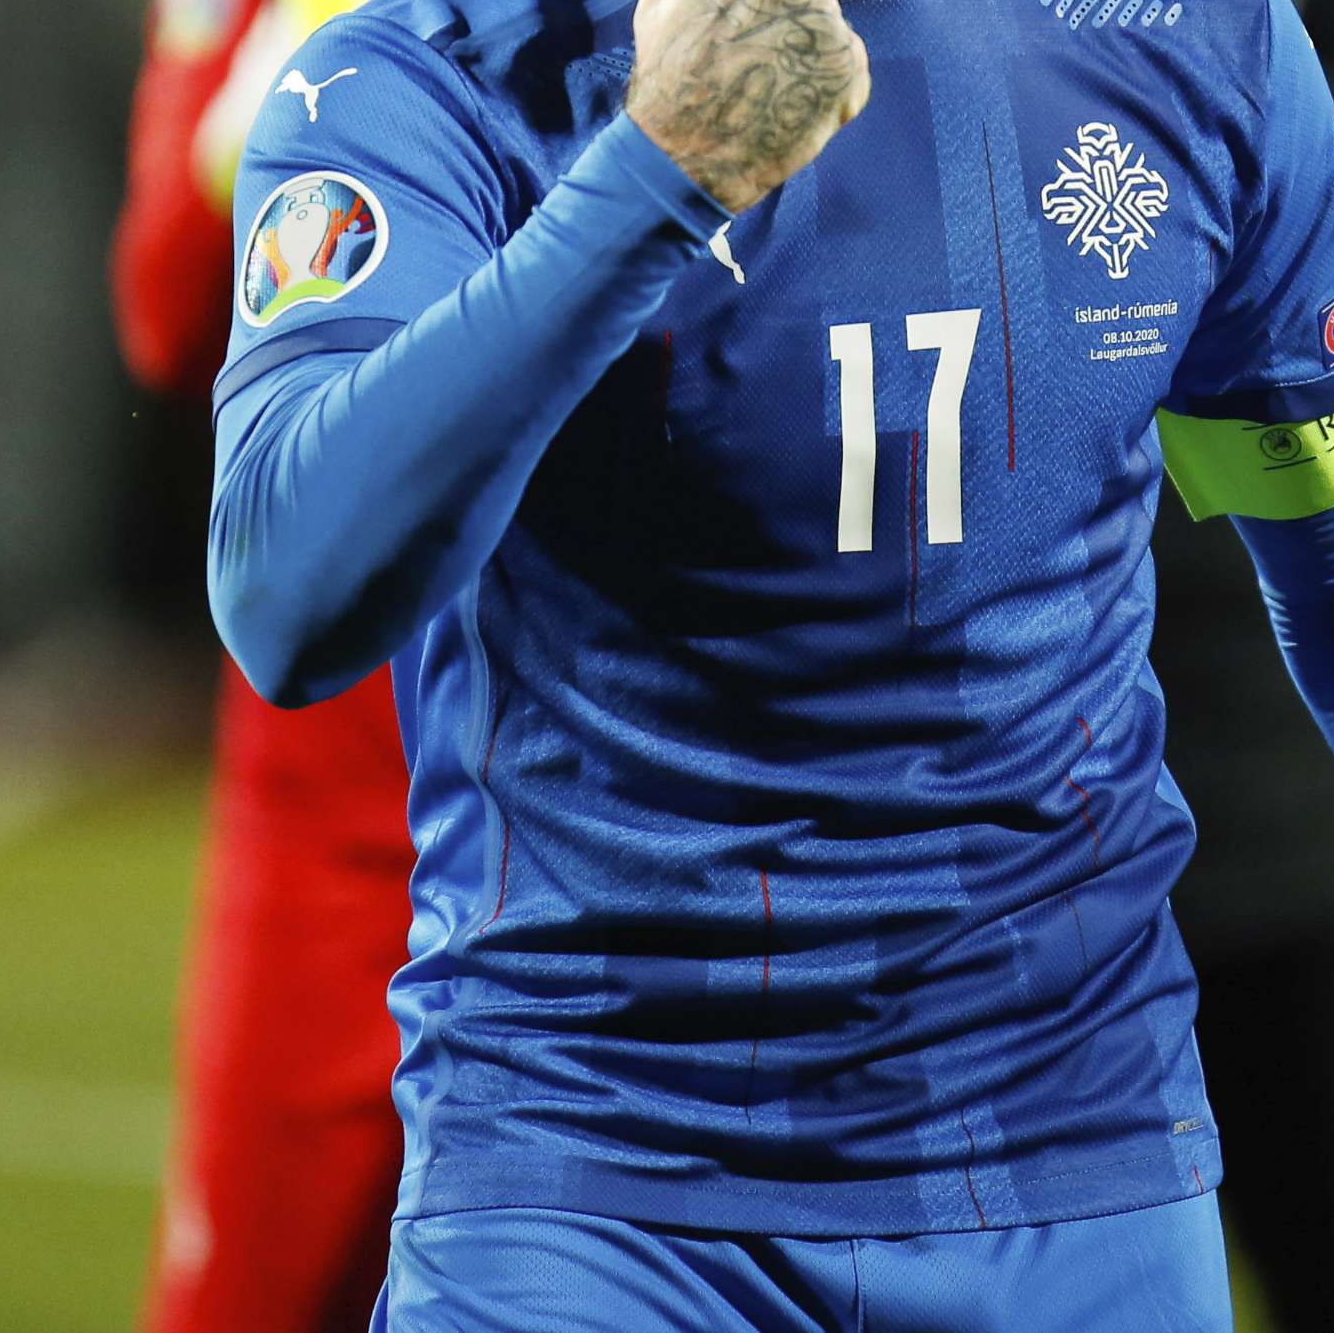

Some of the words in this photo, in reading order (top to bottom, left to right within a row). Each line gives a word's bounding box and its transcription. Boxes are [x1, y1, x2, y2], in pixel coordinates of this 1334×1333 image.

[1103, 328, 1159, 344] 08.10.2020
[1090, 342, 1168, 361] Laugardalsvöllur
[829, 308, 982, 552] 17
